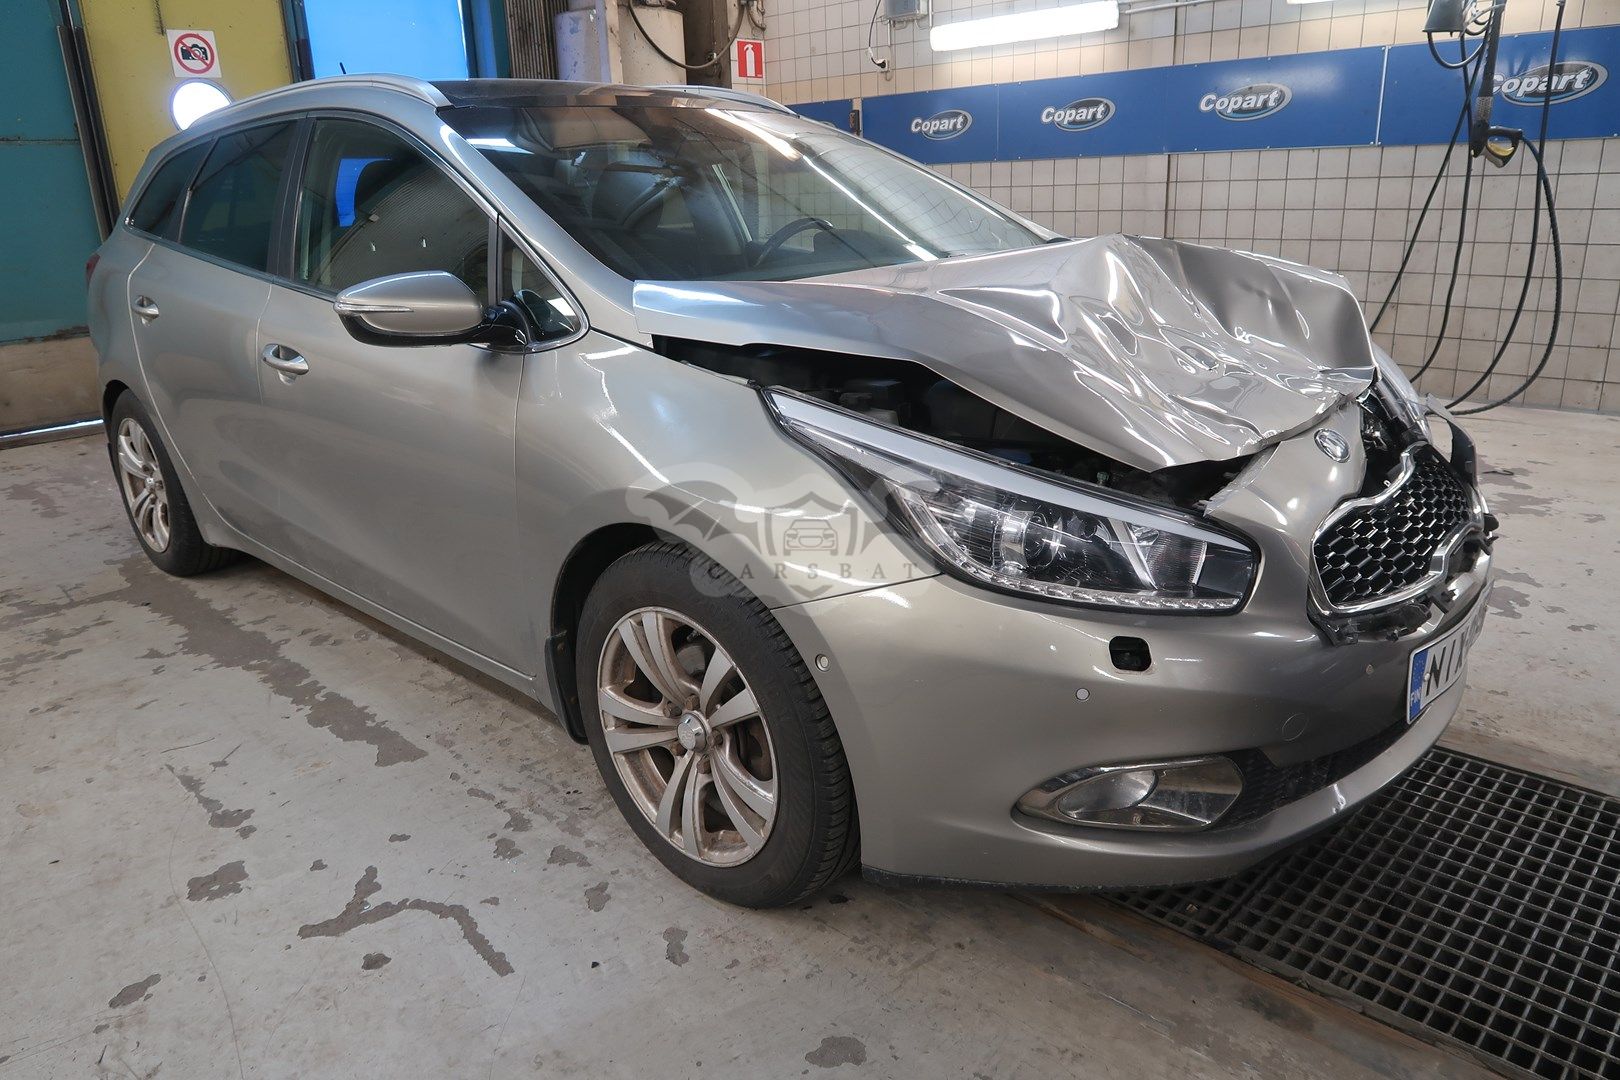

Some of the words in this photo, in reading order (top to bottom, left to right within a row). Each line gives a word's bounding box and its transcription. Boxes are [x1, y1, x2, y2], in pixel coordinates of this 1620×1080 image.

[1199, 90, 1279, 114] Copart
[911, 115, 964, 134] Copart
[1041, 103, 1105, 125] Copart
